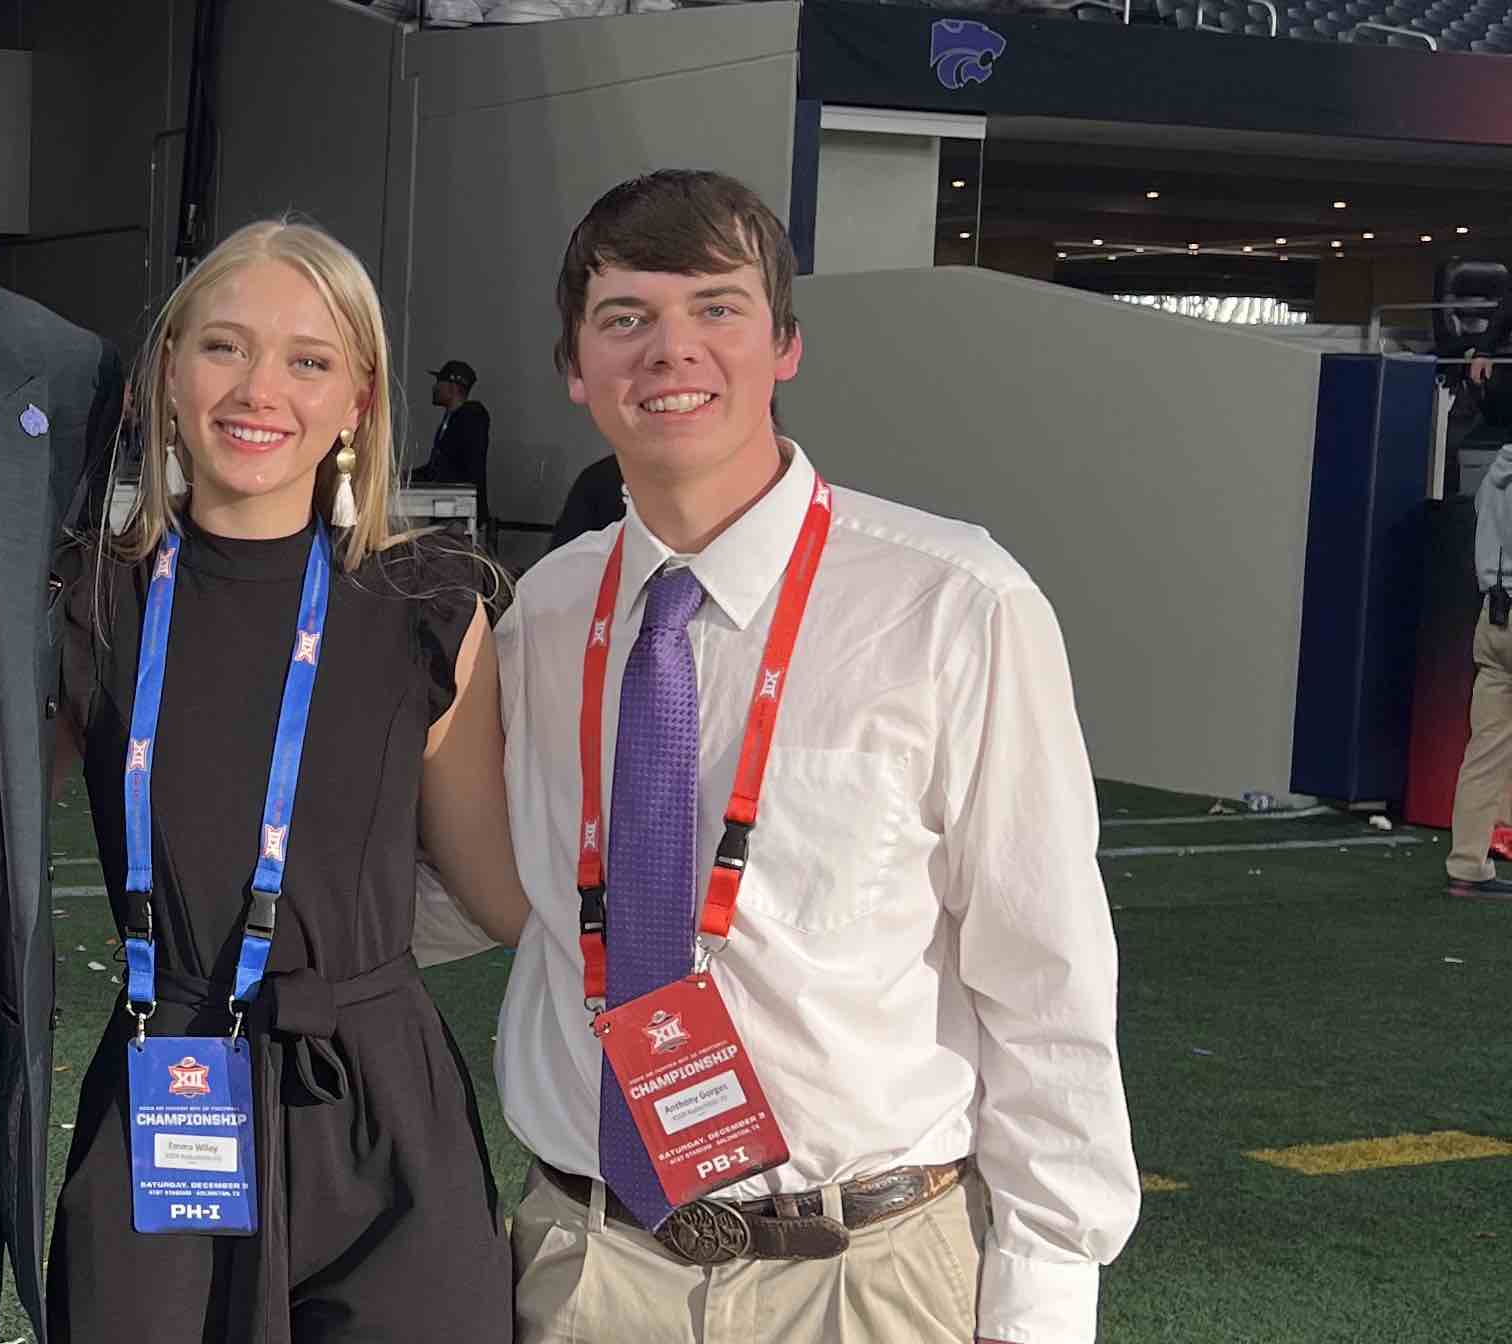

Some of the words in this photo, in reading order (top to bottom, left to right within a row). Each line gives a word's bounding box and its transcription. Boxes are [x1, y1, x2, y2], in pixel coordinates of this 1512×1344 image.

[630, 1043, 738, 1100] CHAMPIONSHIP
[136, 1113, 248, 1126] CHAMPIONSHIP
[696, 1145, 749, 1180] PB-I
[170, 1203, 222, 1220] PH-I
